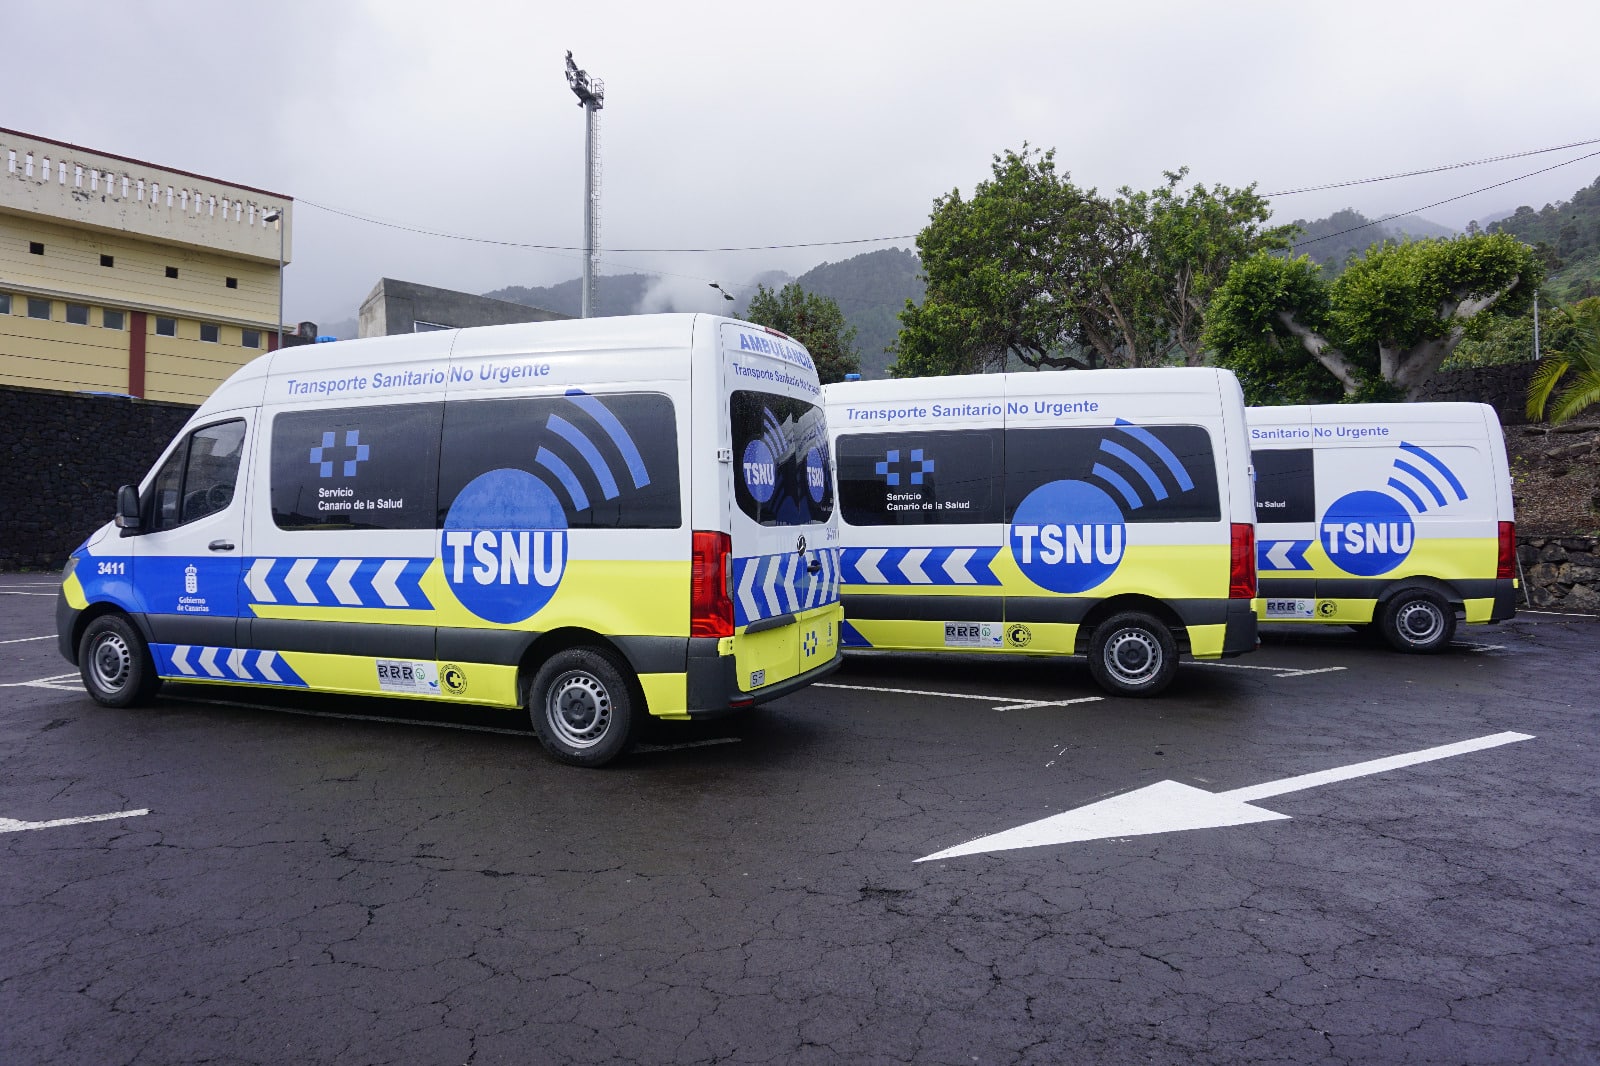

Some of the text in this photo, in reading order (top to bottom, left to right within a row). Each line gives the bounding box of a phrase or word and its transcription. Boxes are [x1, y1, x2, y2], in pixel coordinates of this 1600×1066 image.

[740, 333, 814, 371] AMBULANCIA
[287, 362, 550, 395] Transporte Sanitario No Urgente
[733, 363, 774, 380] Transporte
[846, 400, 1099, 421] Transporte Sanitario No Urgente
[1252, 426, 1389, 438] Sanitario No Urgente
[743, 462, 774, 485] TSNU
[807, 466, 824, 487] TSNU
[318, 487, 353, 497] Servicio
[886, 492, 922, 501] Servicio
[318, 498, 403, 510] Canario de la Salud
[886, 500, 970, 511] Canario de la Salud
[1014, 524, 1122, 565] TSNU
[1323, 522, 1411, 554] TSNU
[97, 562, 124, 574] 3411
[446, 530, 563, 587] TSNU
[176, 604, 209, 613] de Canarias
